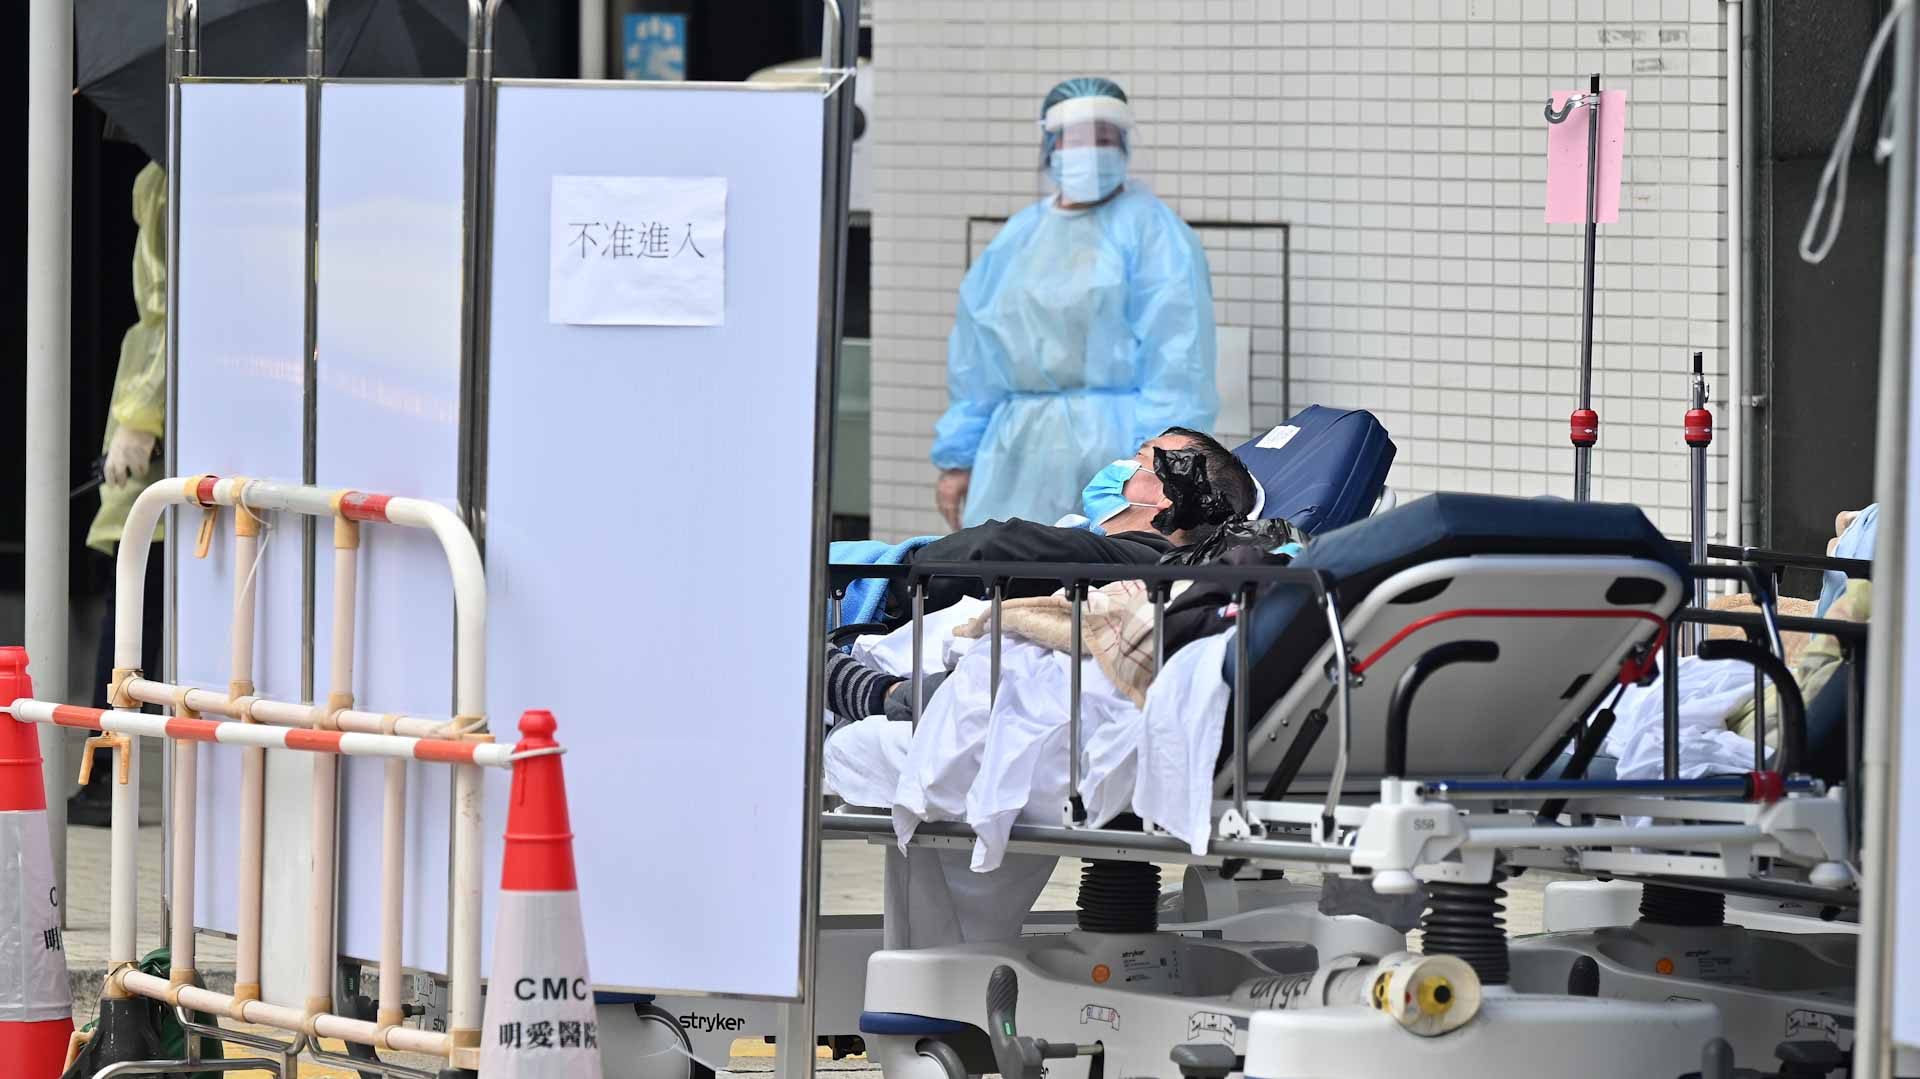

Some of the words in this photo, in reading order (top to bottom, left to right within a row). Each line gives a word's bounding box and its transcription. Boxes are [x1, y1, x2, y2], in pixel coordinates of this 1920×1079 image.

[568, 220, 705, 260] 不准進入
[514, 977, 587, 1001] CMC
[679, 1011, 746, 1033] stryker
